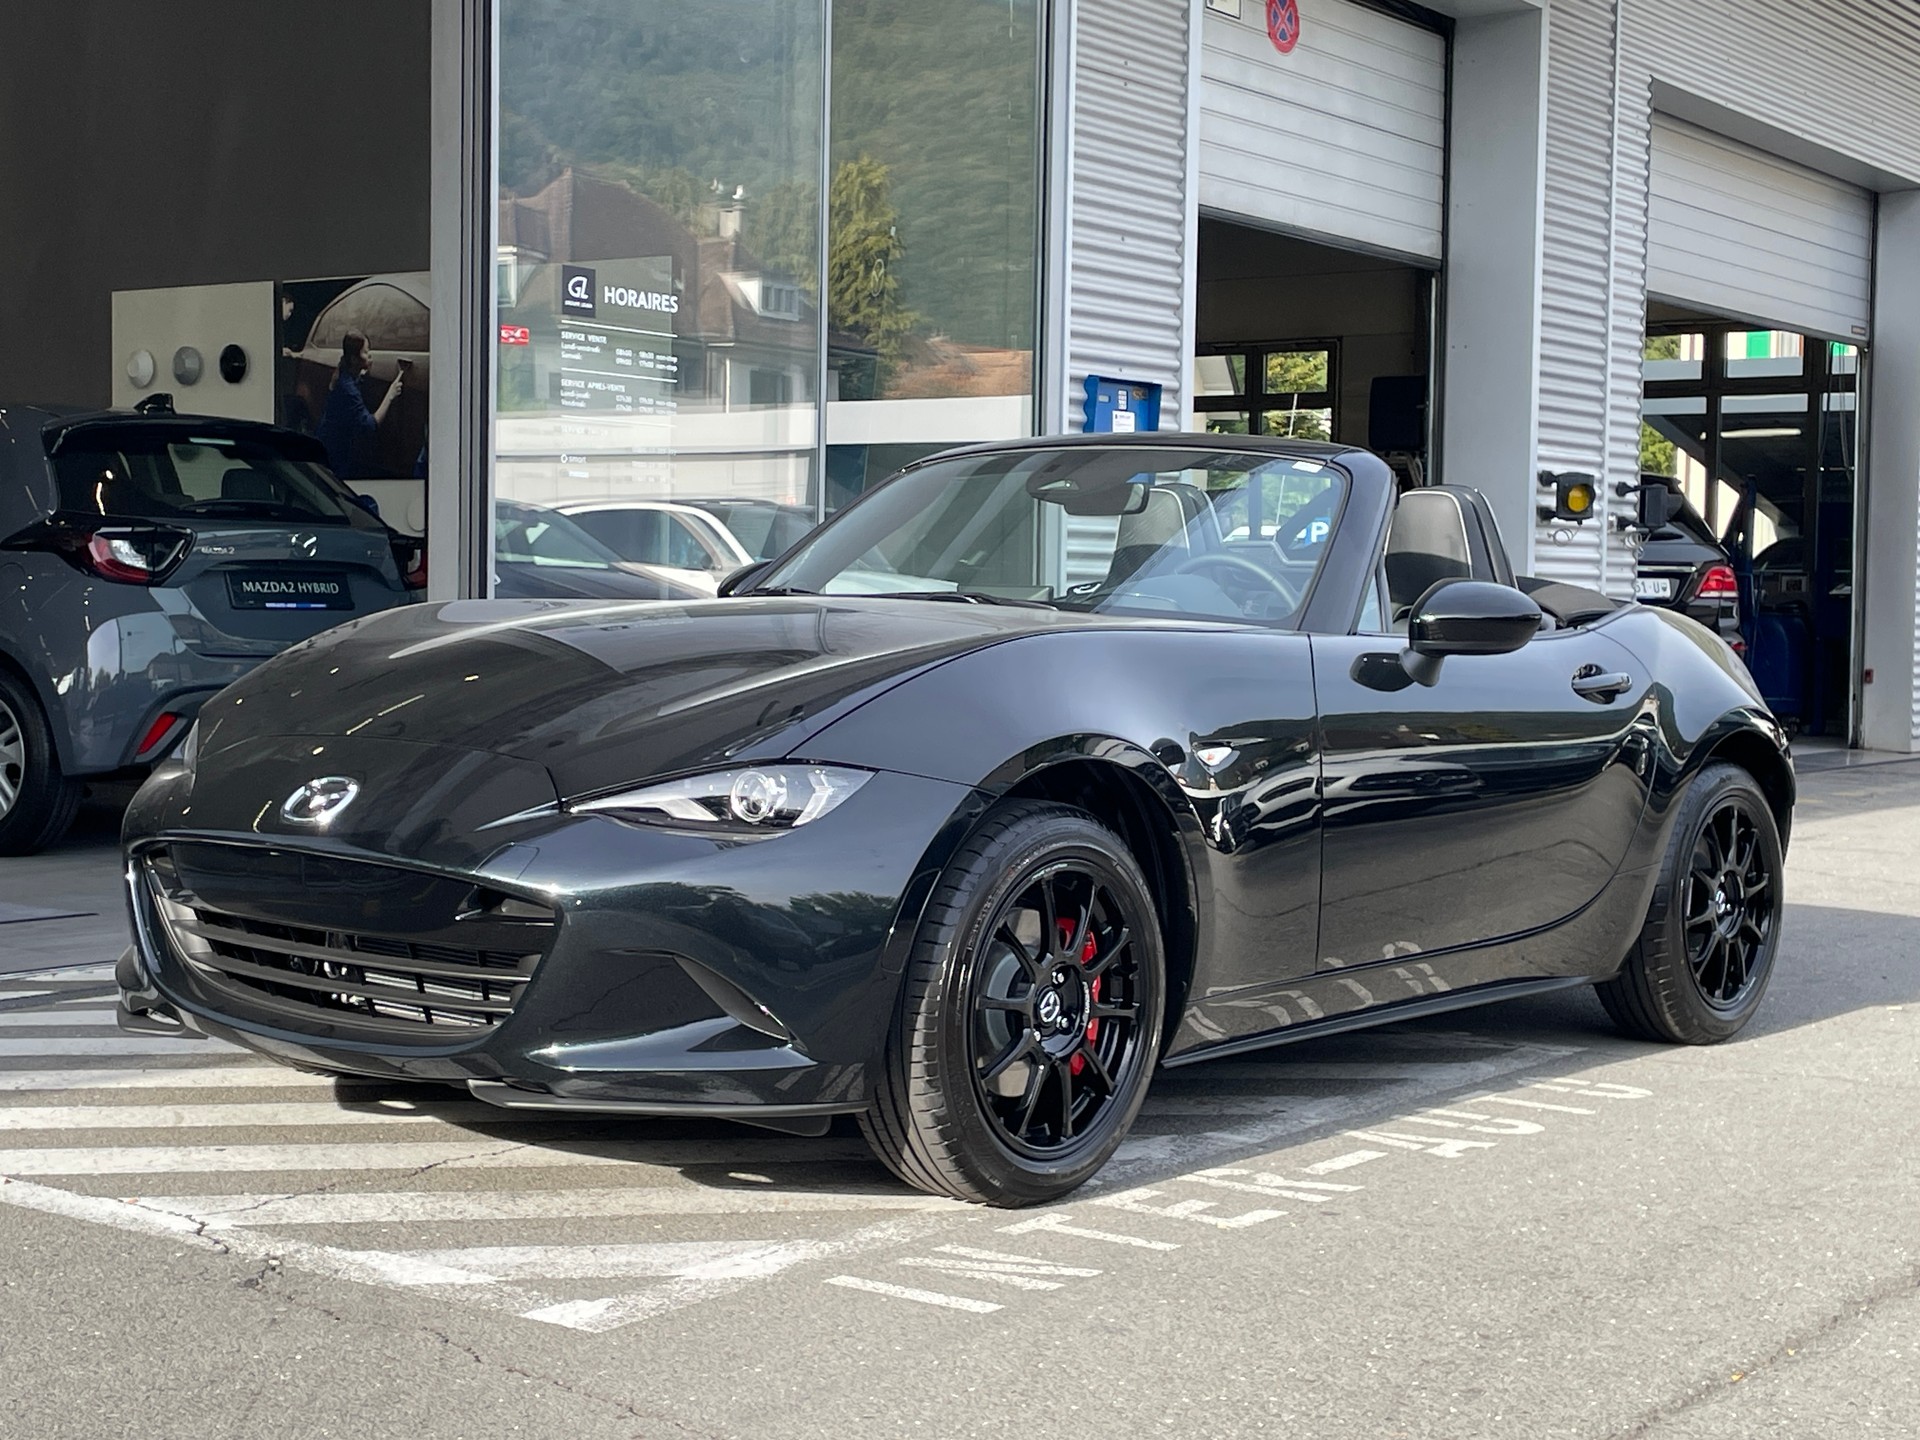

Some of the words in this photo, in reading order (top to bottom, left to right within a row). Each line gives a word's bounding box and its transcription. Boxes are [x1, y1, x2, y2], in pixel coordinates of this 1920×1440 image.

[604, 286, 679, 313] HORAIRES
[1311, 522, 1329, 543] P
[242, 581, 296, 593] MAZDA2
[297, 582, 340, 594] HYBRID
